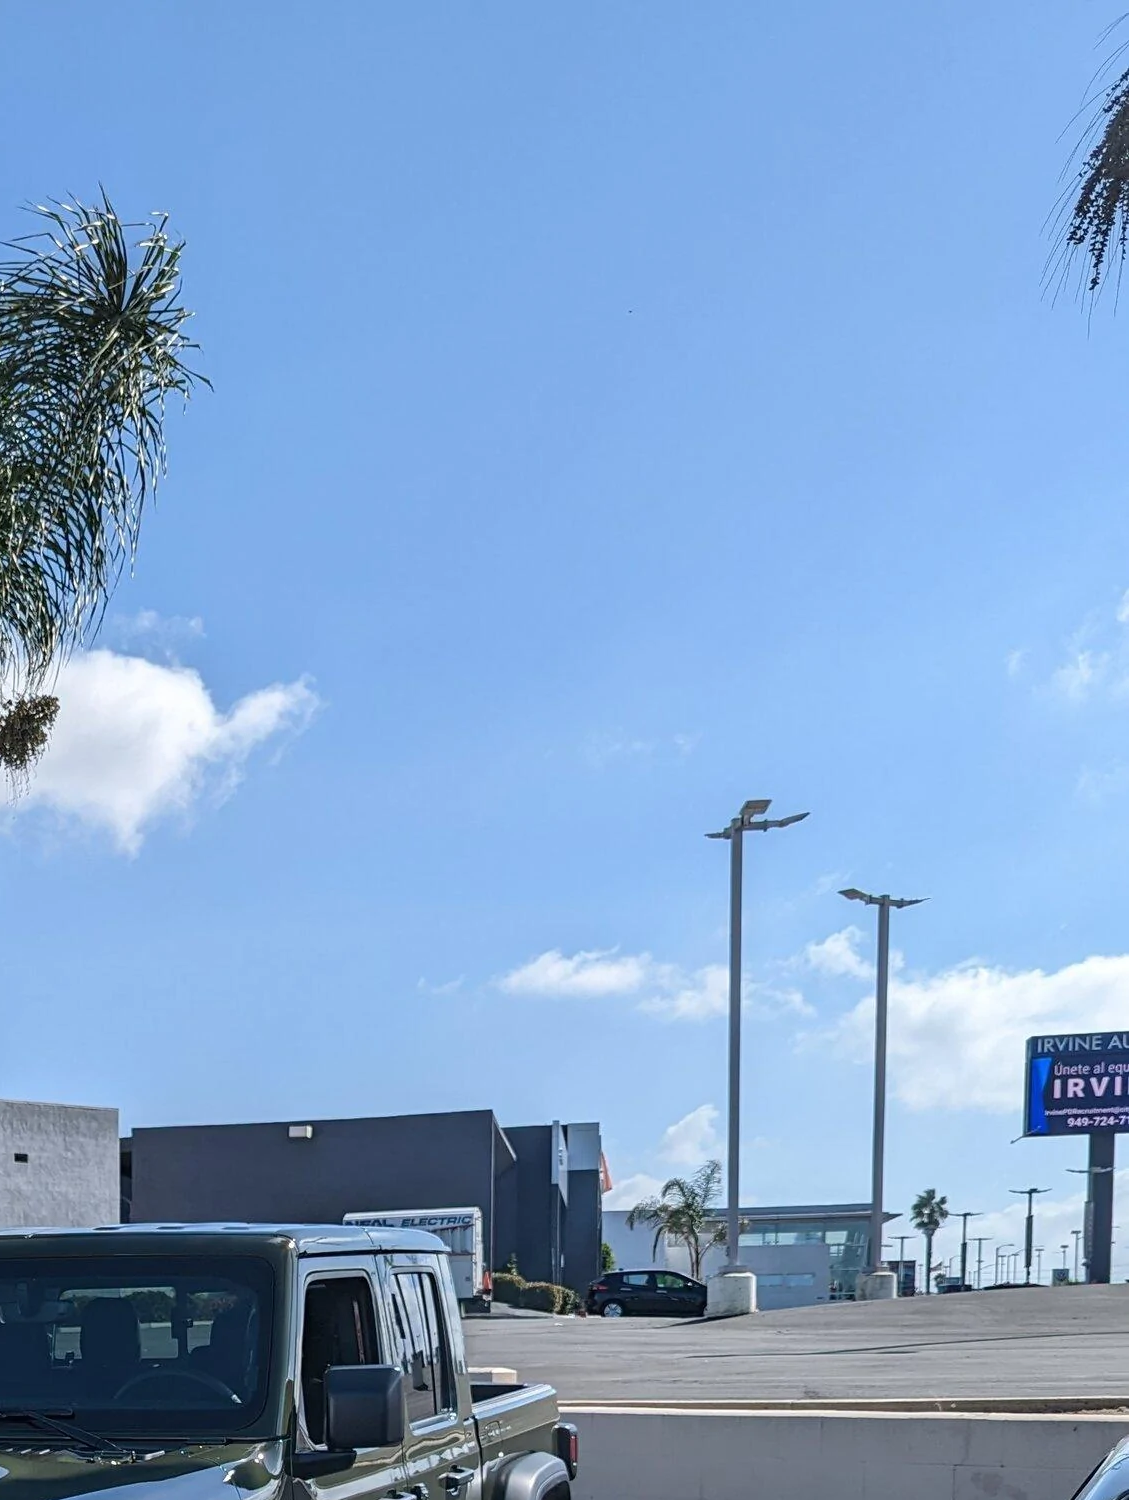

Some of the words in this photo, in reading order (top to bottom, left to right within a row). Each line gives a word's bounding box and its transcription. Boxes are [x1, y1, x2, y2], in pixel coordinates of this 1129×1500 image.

[1037, 1035, 1102, 1053] IRVINE
[1054, 1061, 1090, 1076] Únete
[1093, 1062, 1106, 1074] al
[1053, 1076, 1129, 1099] IRVI
[401, 1215, 472, 1227] ELECTRIC
